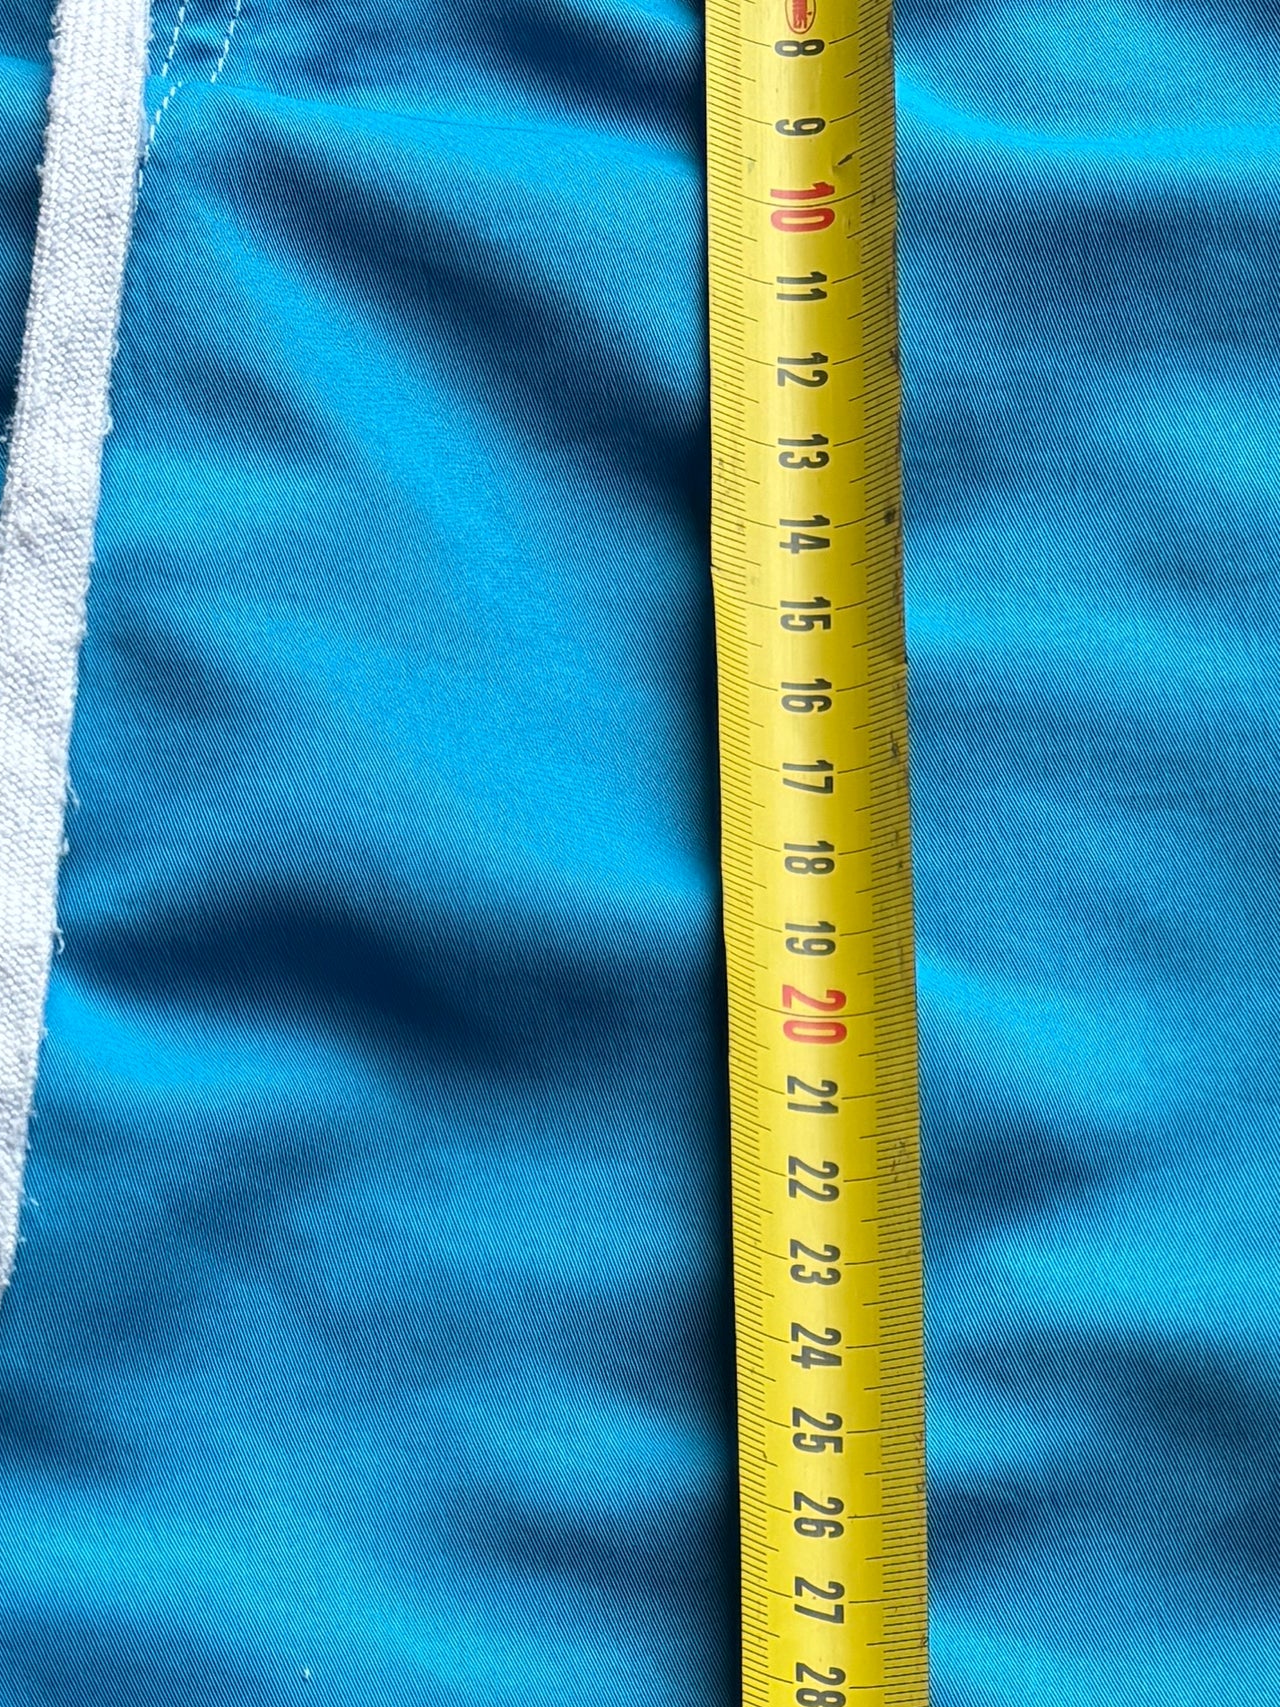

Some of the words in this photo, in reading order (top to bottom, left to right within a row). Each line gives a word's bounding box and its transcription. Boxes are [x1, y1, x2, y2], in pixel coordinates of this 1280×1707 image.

[775, 39, 824, 57] 8
[775, 117, 825, 136] 9
[770, 182, 835, 232] 10
[776, 271, 827, 303] 11
[777, 352, 828, 387] 12
[778, 434, 829, 470] 13
[779, 515, 830, 555] 14
[780, 597, 831, 631] 15
[781, 678, 832, 712] 16
[782, 760, 833, 794] 17
[784, 840, 835, 875] 18
[785, 921, 836, 956] 19
[782, 984, 847, 1044] 20
[787, 1075, 839, 1114] 21
[788, 1155, 840, 1202] 22
[790, 1239, 841, 1285] 23
[791, 1322, 842, 1369] 24
[792, 1407, 843, 1453] 25
[794, 1491, 844, 1538] 26
[794, 1576, 845, 1624] 27
